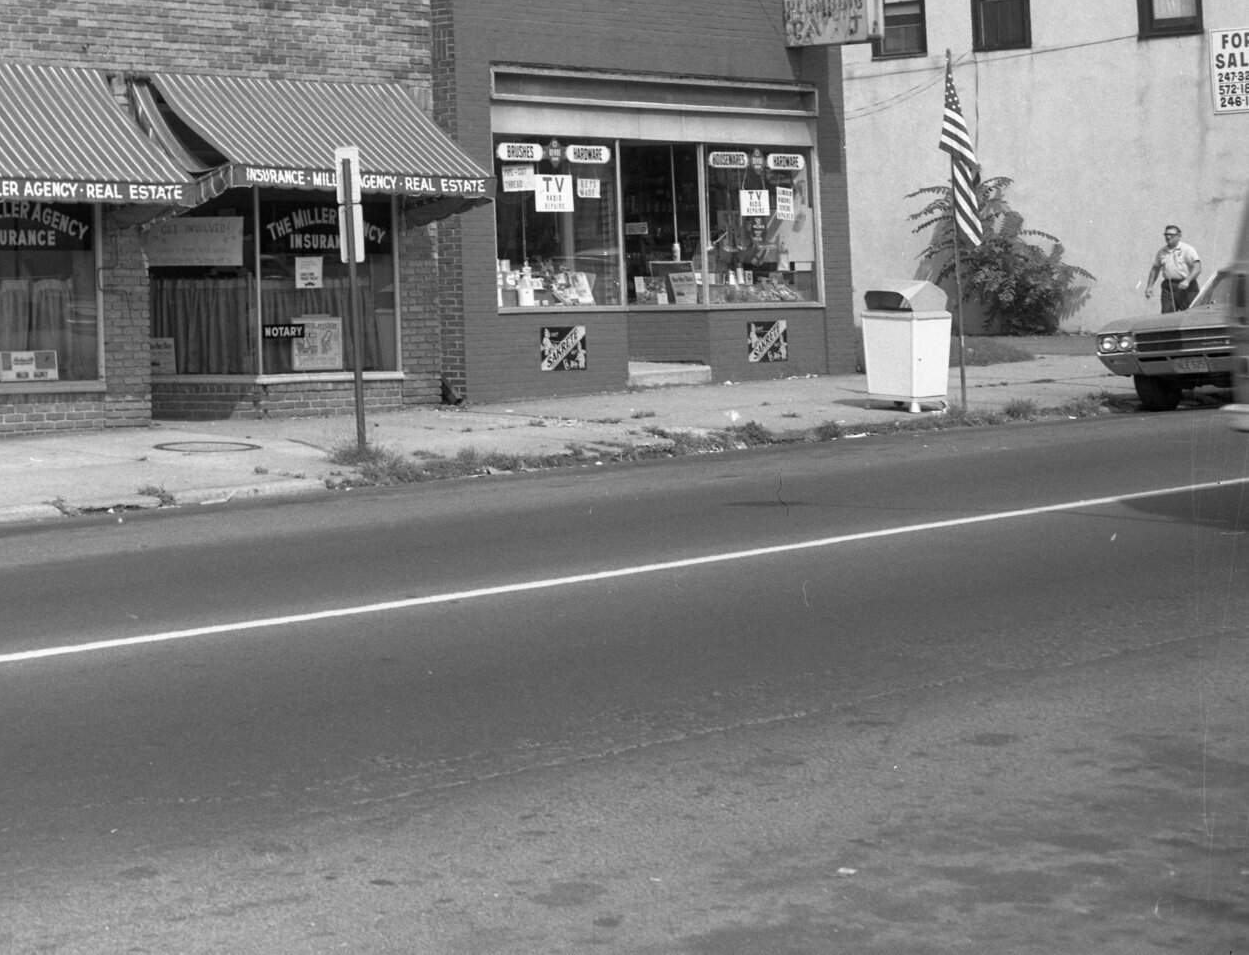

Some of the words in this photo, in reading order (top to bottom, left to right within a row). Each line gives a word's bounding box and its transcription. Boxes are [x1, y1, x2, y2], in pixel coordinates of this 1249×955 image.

[507, 145, 534, 159] BRUSHES
[573, 147, 603, 161] HARDWARE
[773, 155, 799, 169] HARDWARE
[246, 167, 306, 185] INSURANCE
[312, 171, 338, 187] MILL
[405, 176, 436, 192] REAL
[440, 178, 486, 193] ESTATE
[23, 181, 79, 198] AGENCY
[86, 183, 123, 199] REAL
[128, 185, 183, 200] ESTATE
[31, 203, 89, 240] AGENCY
[266, 216, 293, 241] THE
[292, 207, 338, 230] MILLER
[290, 233, 341, 249] INSURAN
[264, 326, 303, 337] NOTARY
